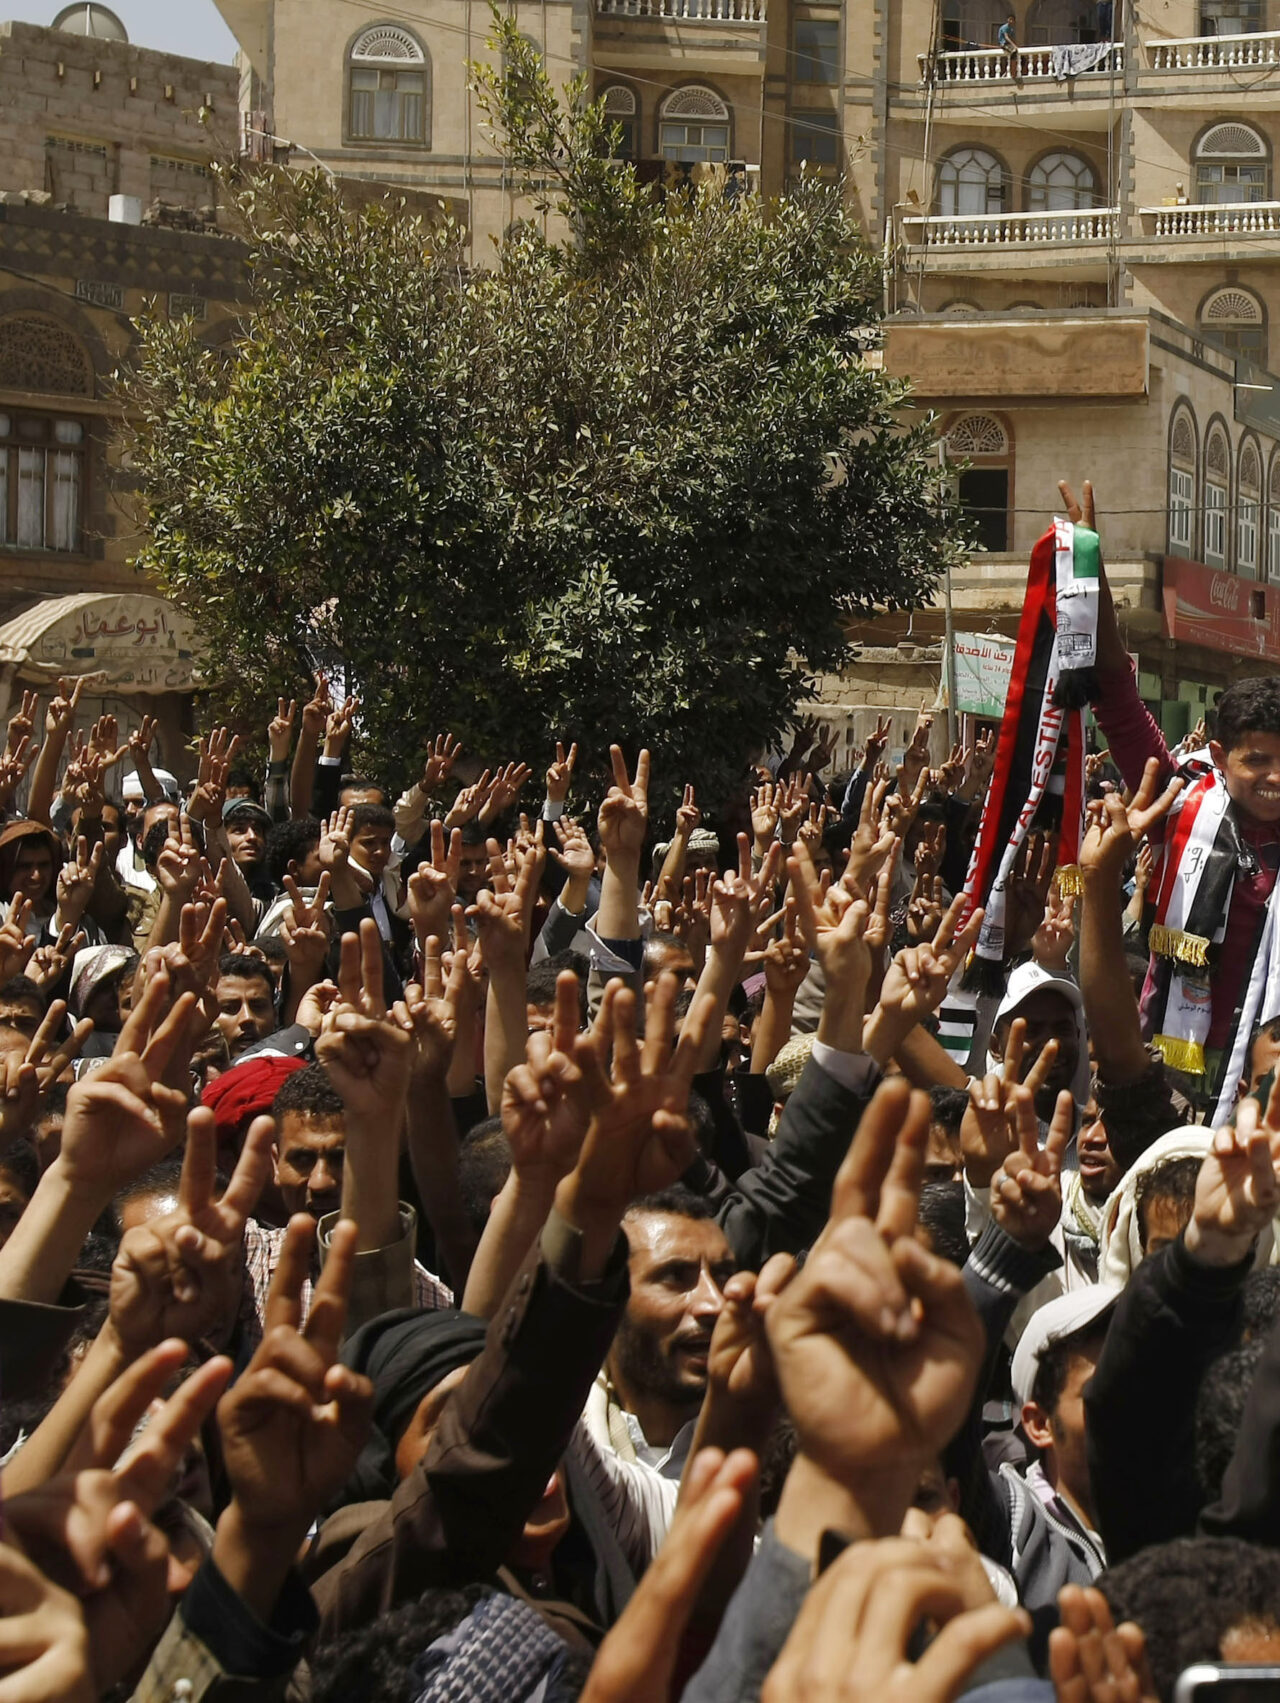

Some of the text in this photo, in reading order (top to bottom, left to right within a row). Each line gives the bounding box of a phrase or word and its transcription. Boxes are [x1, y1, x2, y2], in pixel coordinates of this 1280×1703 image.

[132, 609, 168, 646] أبو
[954, 643, 1013, 664] ركن الأصدقا
